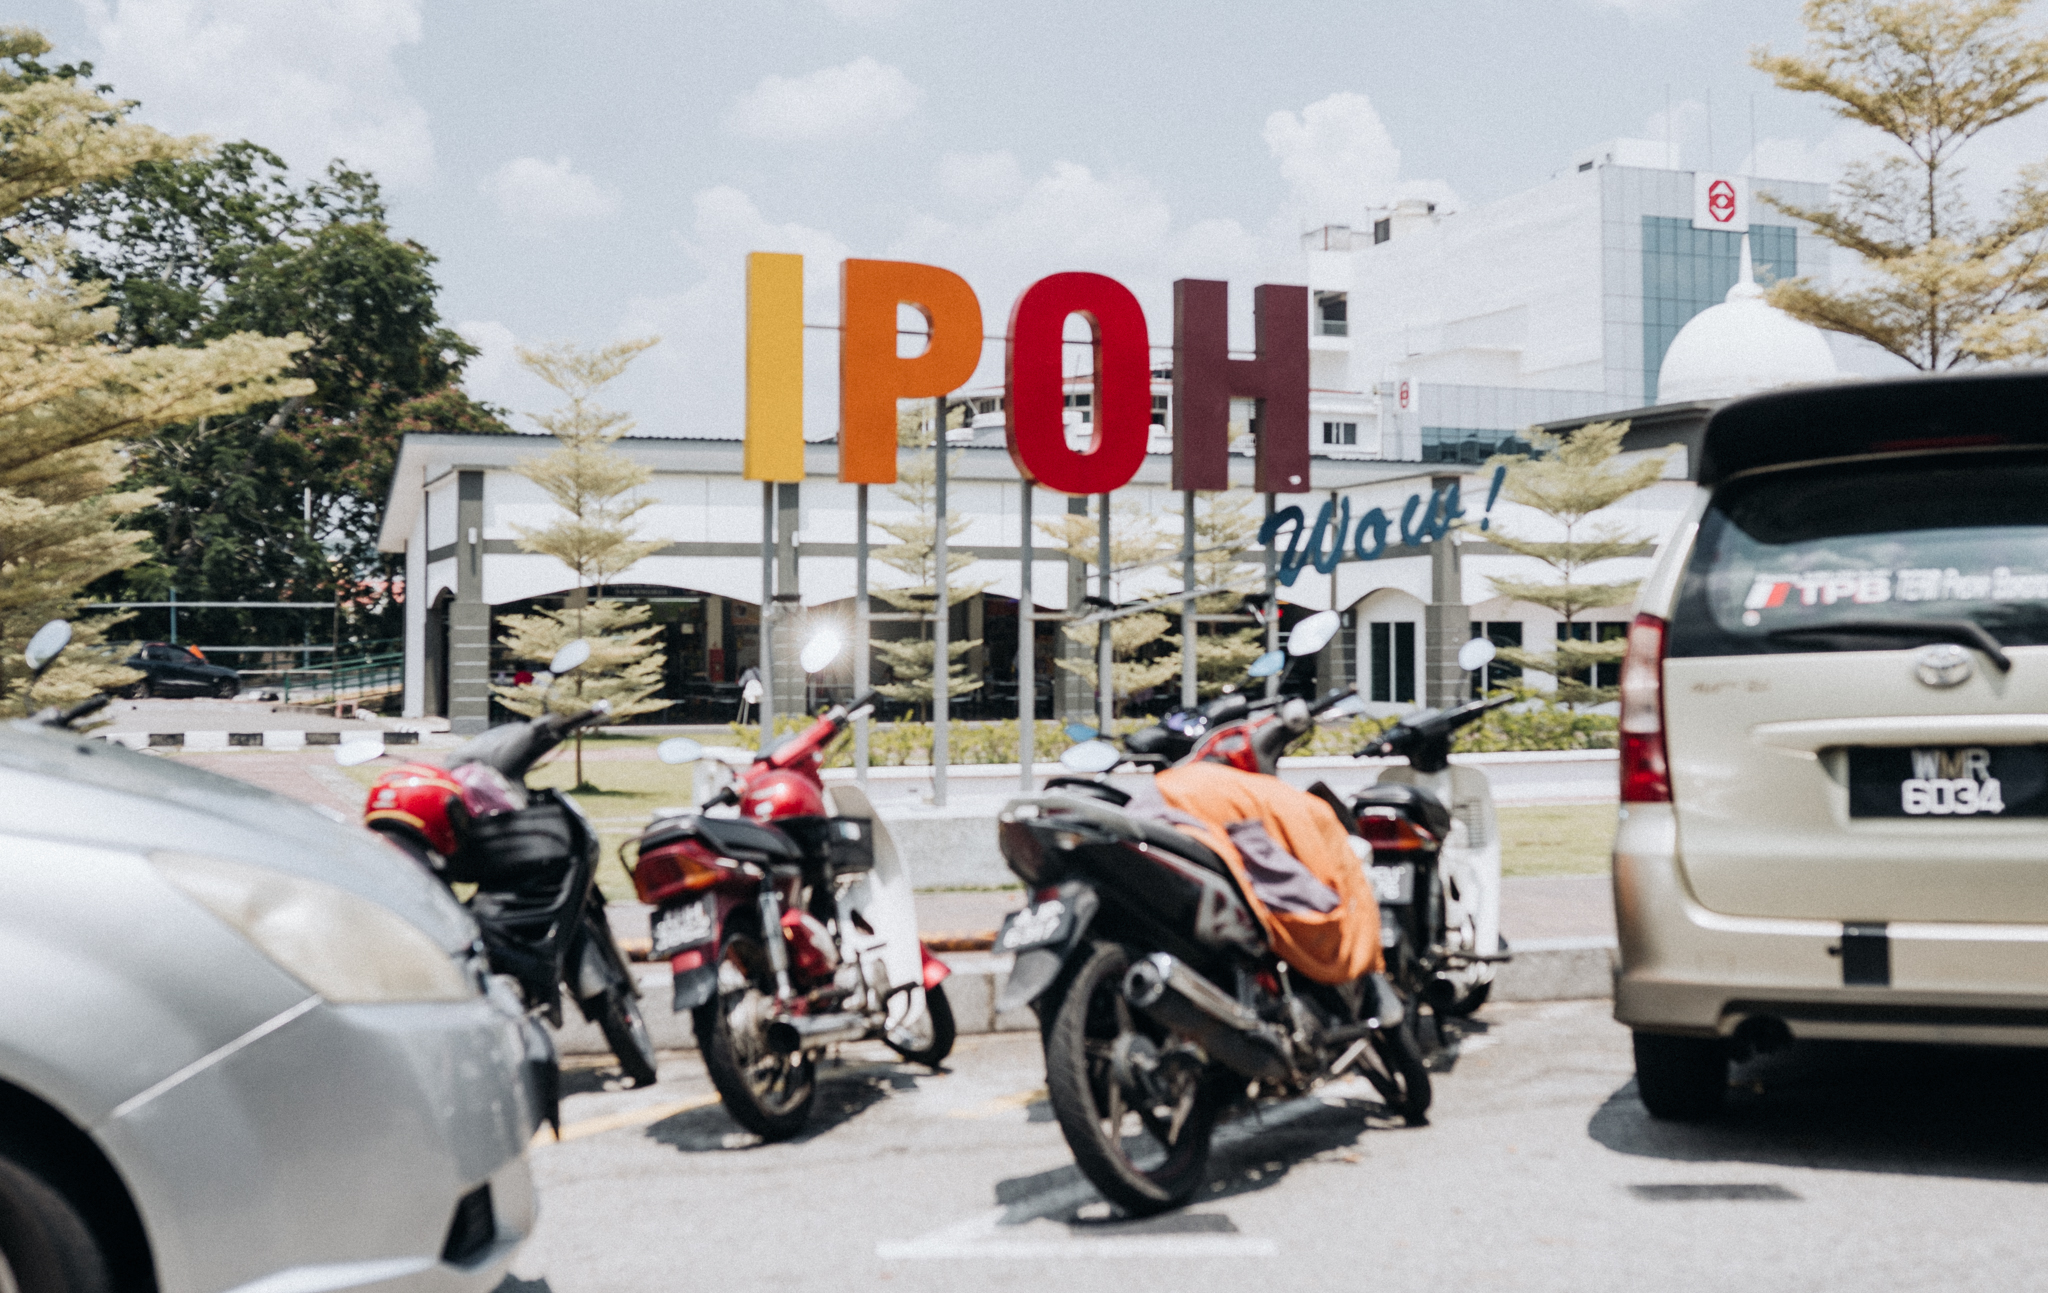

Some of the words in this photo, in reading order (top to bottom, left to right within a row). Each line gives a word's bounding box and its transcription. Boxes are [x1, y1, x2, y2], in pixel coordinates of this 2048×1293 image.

[744, 252, 1311, 494] IPOH
[1257, 466, 1507, 587] Wow!
[1901, 778, 2006, 814] 6034
[1911, 748, 1991, 781] WMR
